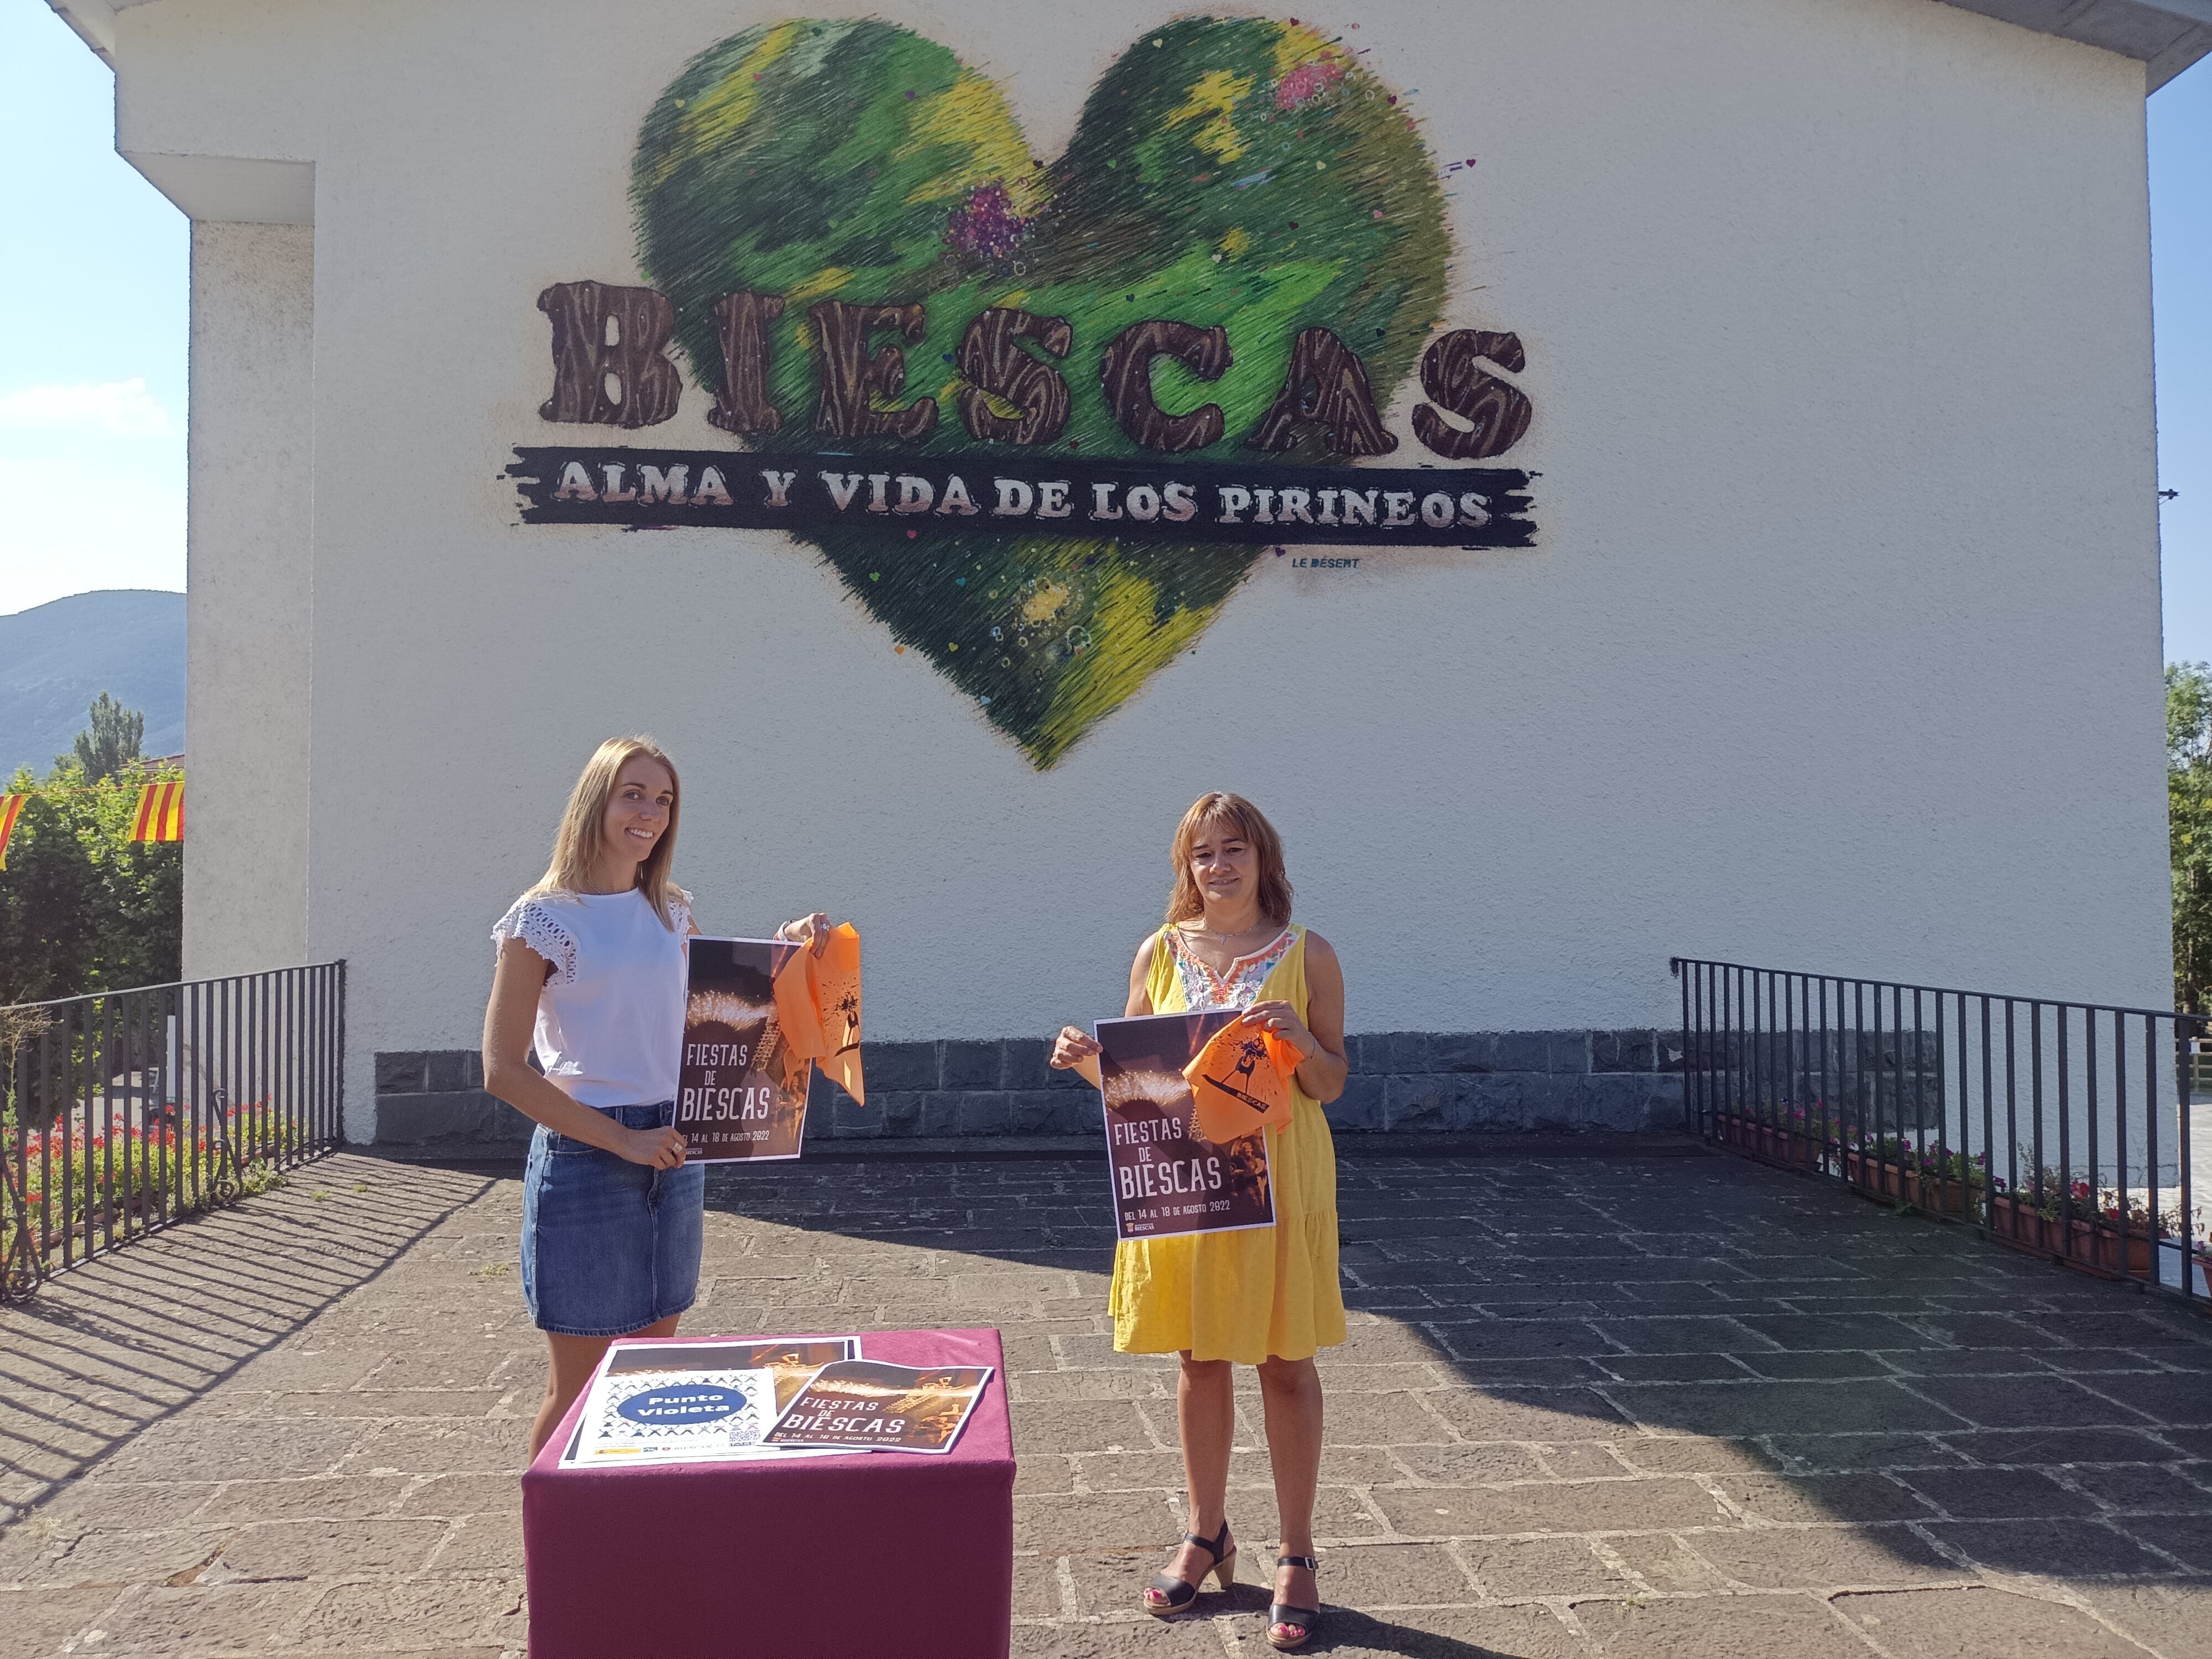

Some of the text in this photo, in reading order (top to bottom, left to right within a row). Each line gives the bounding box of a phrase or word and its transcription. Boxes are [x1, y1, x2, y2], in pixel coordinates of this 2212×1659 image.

[537, 280, 1532, 459] BIESCAS
[552, 461, 1494, 529] ALMA Y VIDA DE LOS PIRINEOS
[1292, 557, 1307, 568] LE
[686, 1043, 748, 1066] FIESTAS
[704, 1070, 717, 1086] DE
[680, 1087, 770, 1121] BIESCAS
[1236, 1092, 1267, 1109] BIESCAS
[691, 1133, 699, 1143] 14
[701, 1134, 708, 1143] AL
[712, 1132, 720, 1142] 18
[722, 1133, 729, 1142] DE
[730, 1132, 750, 1142] AGOSTO
[1114, 1117, 1182, 1145] FIESTAS
[1138, 1146, 1152, 1162] DE
[1119, 1156, 1222, 1199] BIESCAS
[1124, 1211, 1135, 1221] DEL
[1138, 1209, 1147, 1219] 14
[1150, 1209, 1158, 1218] AL
[1161, 1206, 1170, 1217] 18
[1173, 1207, 1181, 1216] DE
[1183, 1203, 1207, 1214] AGOSTO
[649, 1395, 723, 1405] Punto
[800, 1397, 879, 1411] FIESTAS
[638, 1405, 729, 1416] Violeta
[782, 1413, 905, 1433] BIESCAS
